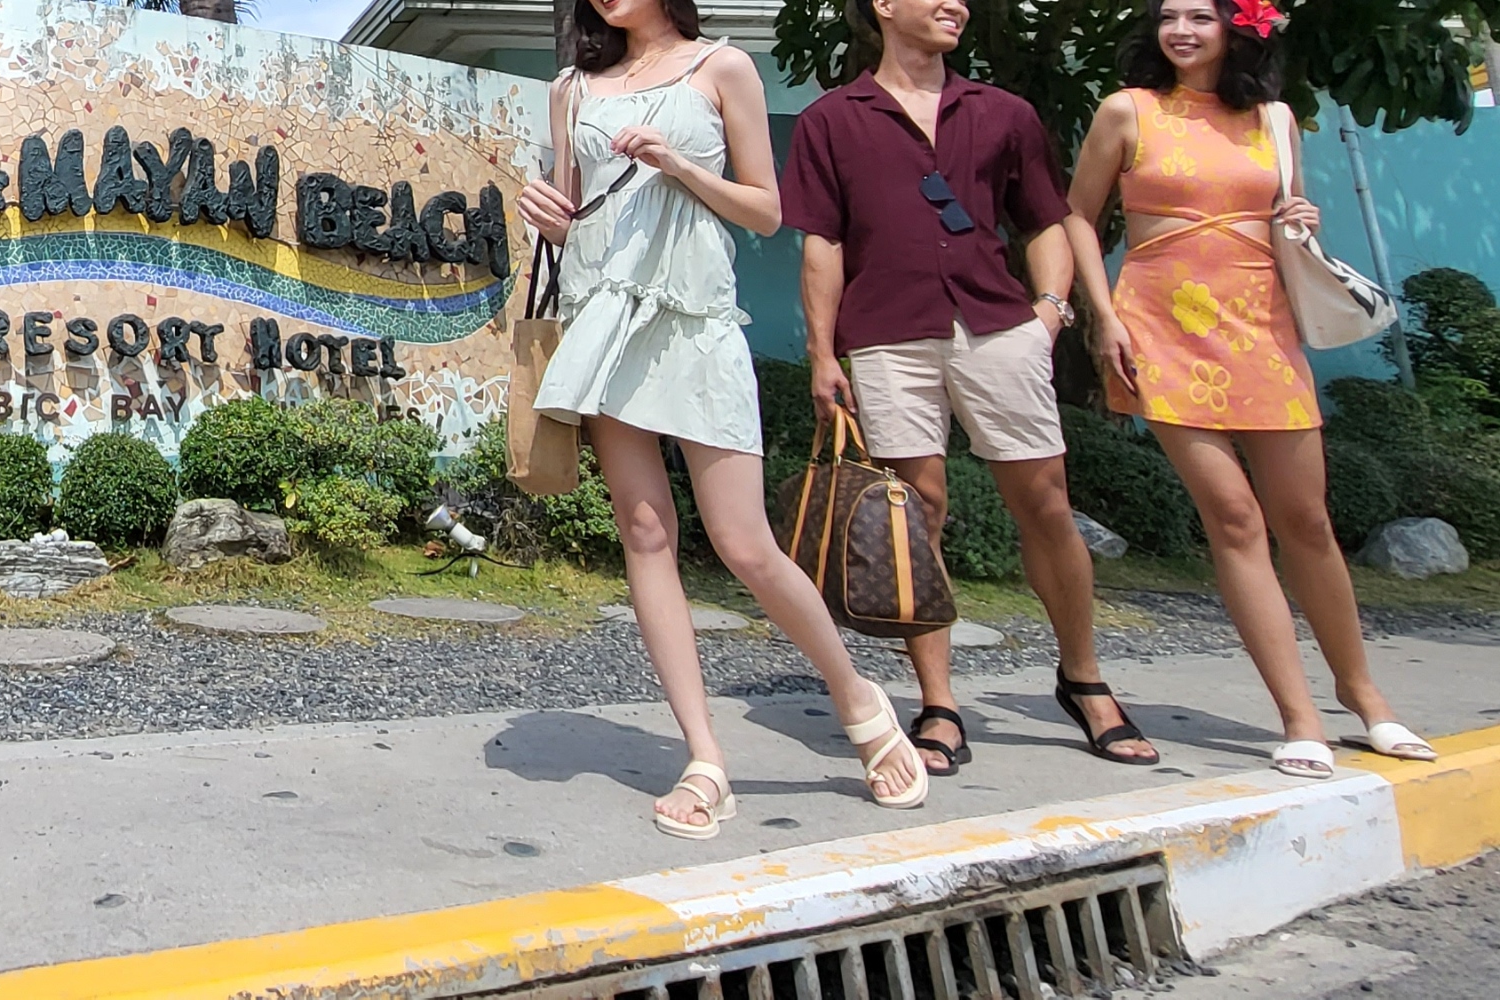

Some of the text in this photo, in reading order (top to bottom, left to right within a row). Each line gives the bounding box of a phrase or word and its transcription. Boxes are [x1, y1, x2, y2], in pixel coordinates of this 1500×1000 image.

[296, 172, 511, 280] BEACH
[250, 316, 407, 380] HOTEL
[111, 394, 187, 423] BAY
